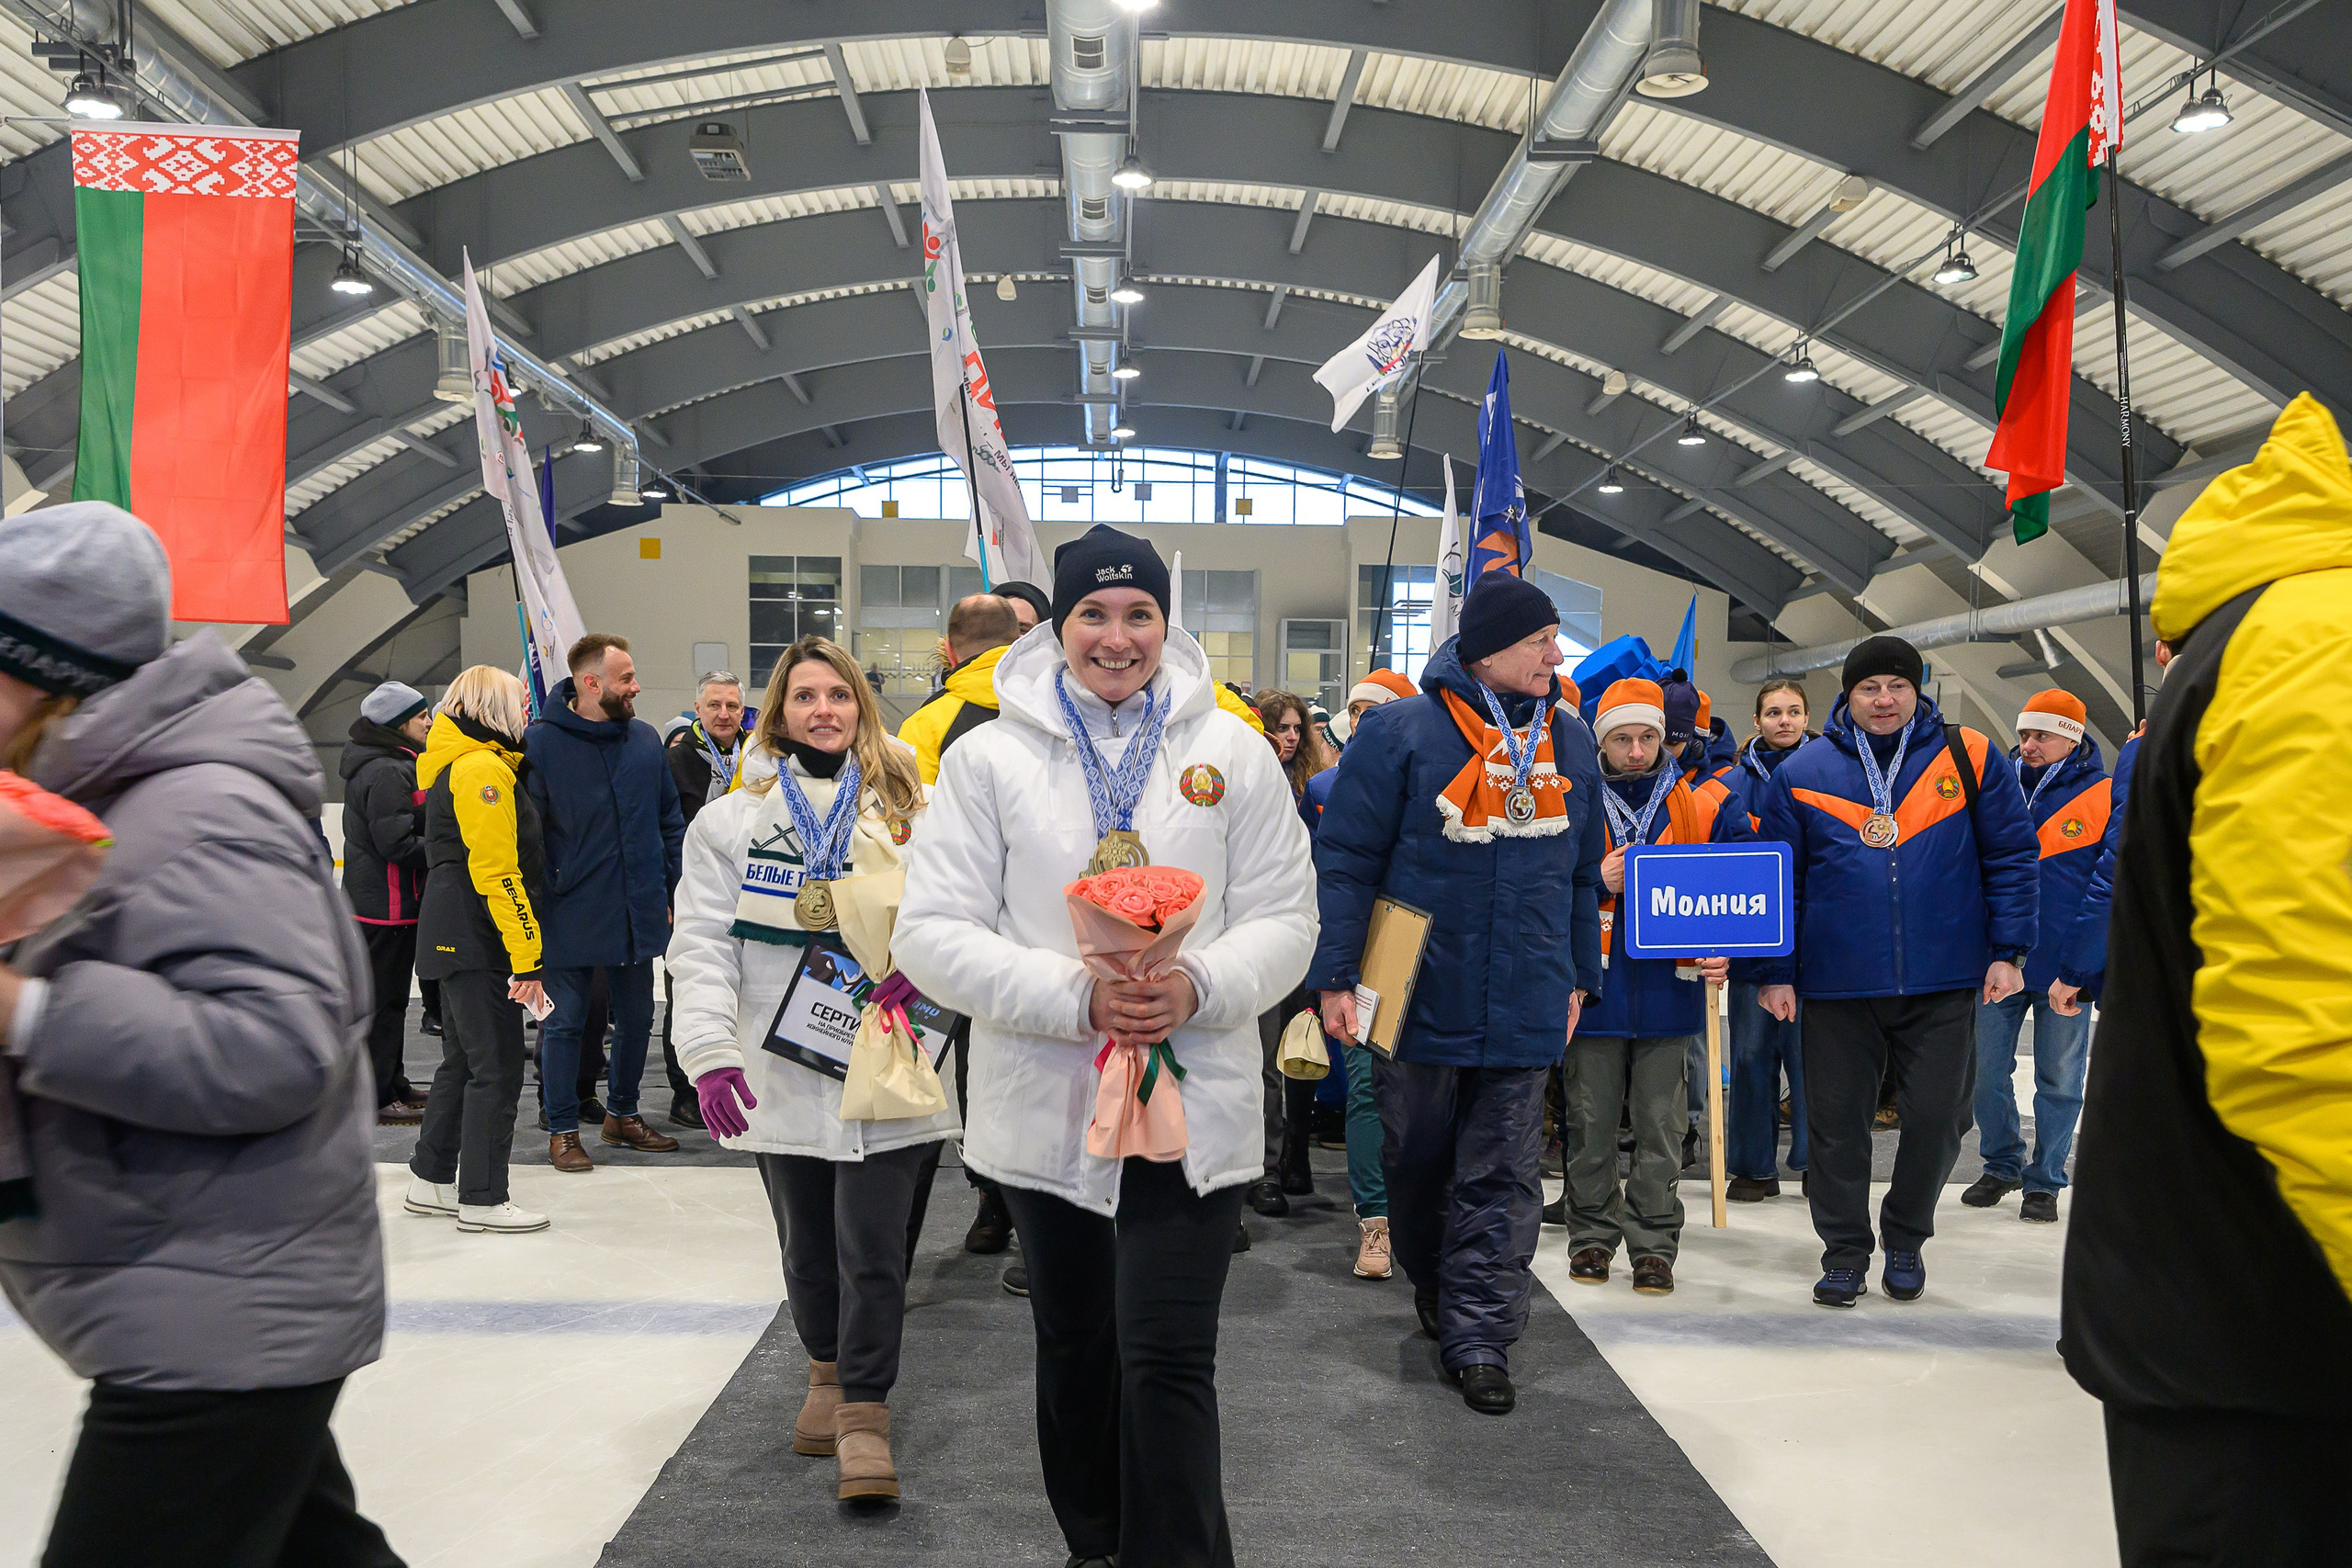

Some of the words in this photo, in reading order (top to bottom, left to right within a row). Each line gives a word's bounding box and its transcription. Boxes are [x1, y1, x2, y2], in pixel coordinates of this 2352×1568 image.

[2120, 396, 2131, 447] HARMONY
[1095, 565, 1115, 576] Jack
[1095, 571, 1134, 583] Wolfskin
[745, 863, 795, 886] БЕЛЫЕ
[501, 876, 536, 942] BELARUS
[1651, 885, 1767, 917] Молния
